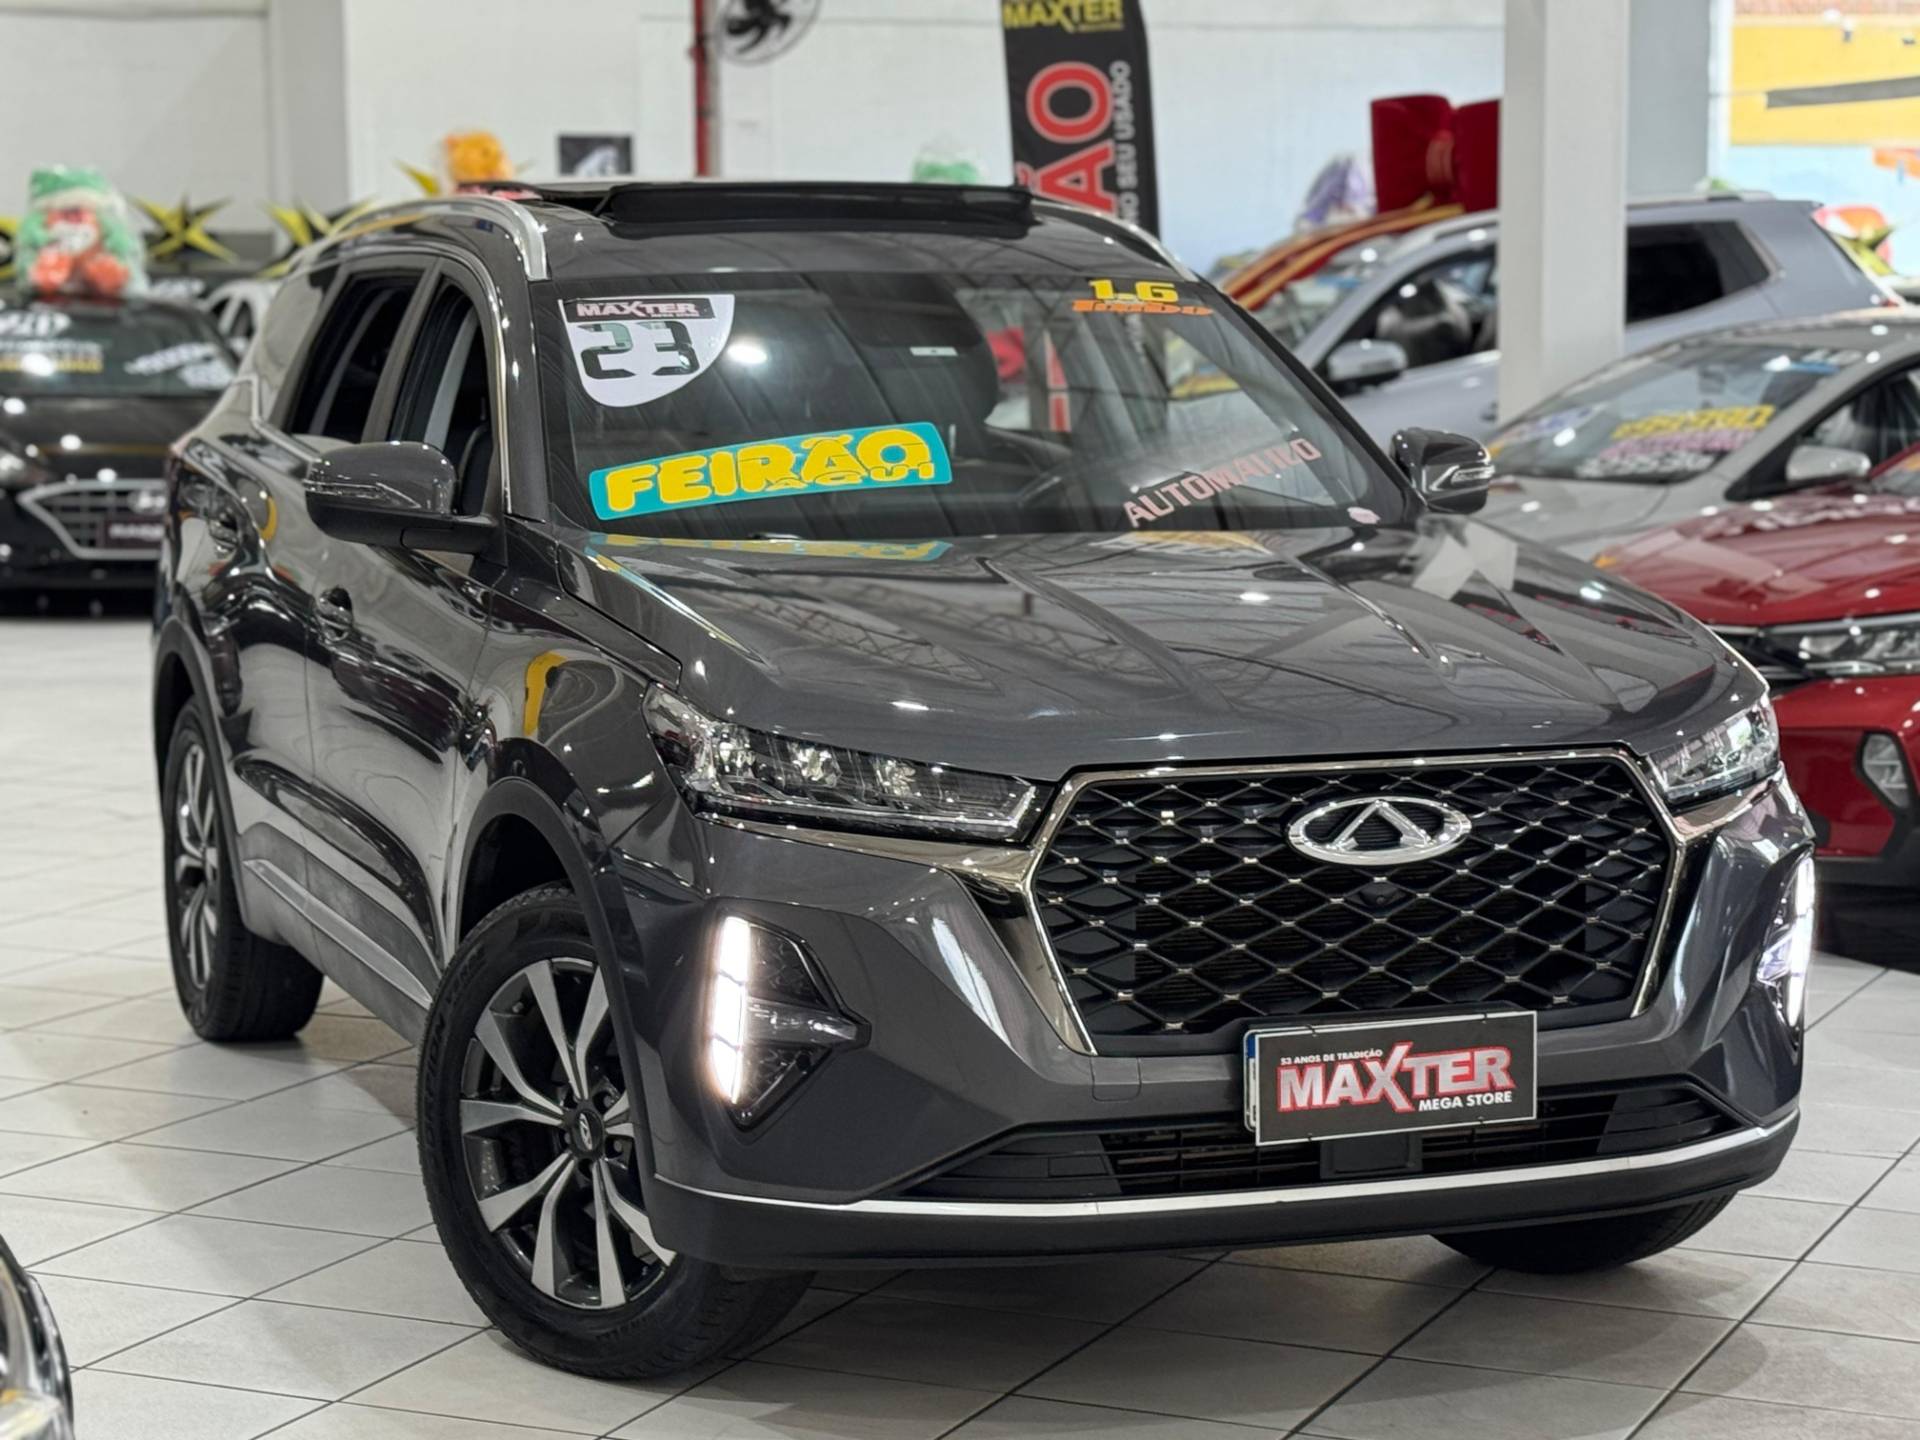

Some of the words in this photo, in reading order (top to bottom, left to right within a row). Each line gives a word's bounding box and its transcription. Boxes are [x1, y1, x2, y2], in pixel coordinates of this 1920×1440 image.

[1003, 0, 1122, 32] MAXTER
[1109, 60, 1136, 140] USADO
[1116, 143, 1138, 189] SEU
[576, 301, 699, 317] MAXTER
[1089, 279, 1179, 303] 1.6
[578, 320, 700, 380] 23
[605, 428, 931, 512] FEIRÃO
[1294, 1054, 1321, 1064] ANOS
[1323, 1053, 1335, 1062] DE
[1337, 1047, 1383, 1061] TRADIÇÃO
[1277, 1041, 1516, 1113] MAXTER
[1419, 1097, 1463, 1112] MEGA
[1466, 1091, 1513, 1107] STORE
